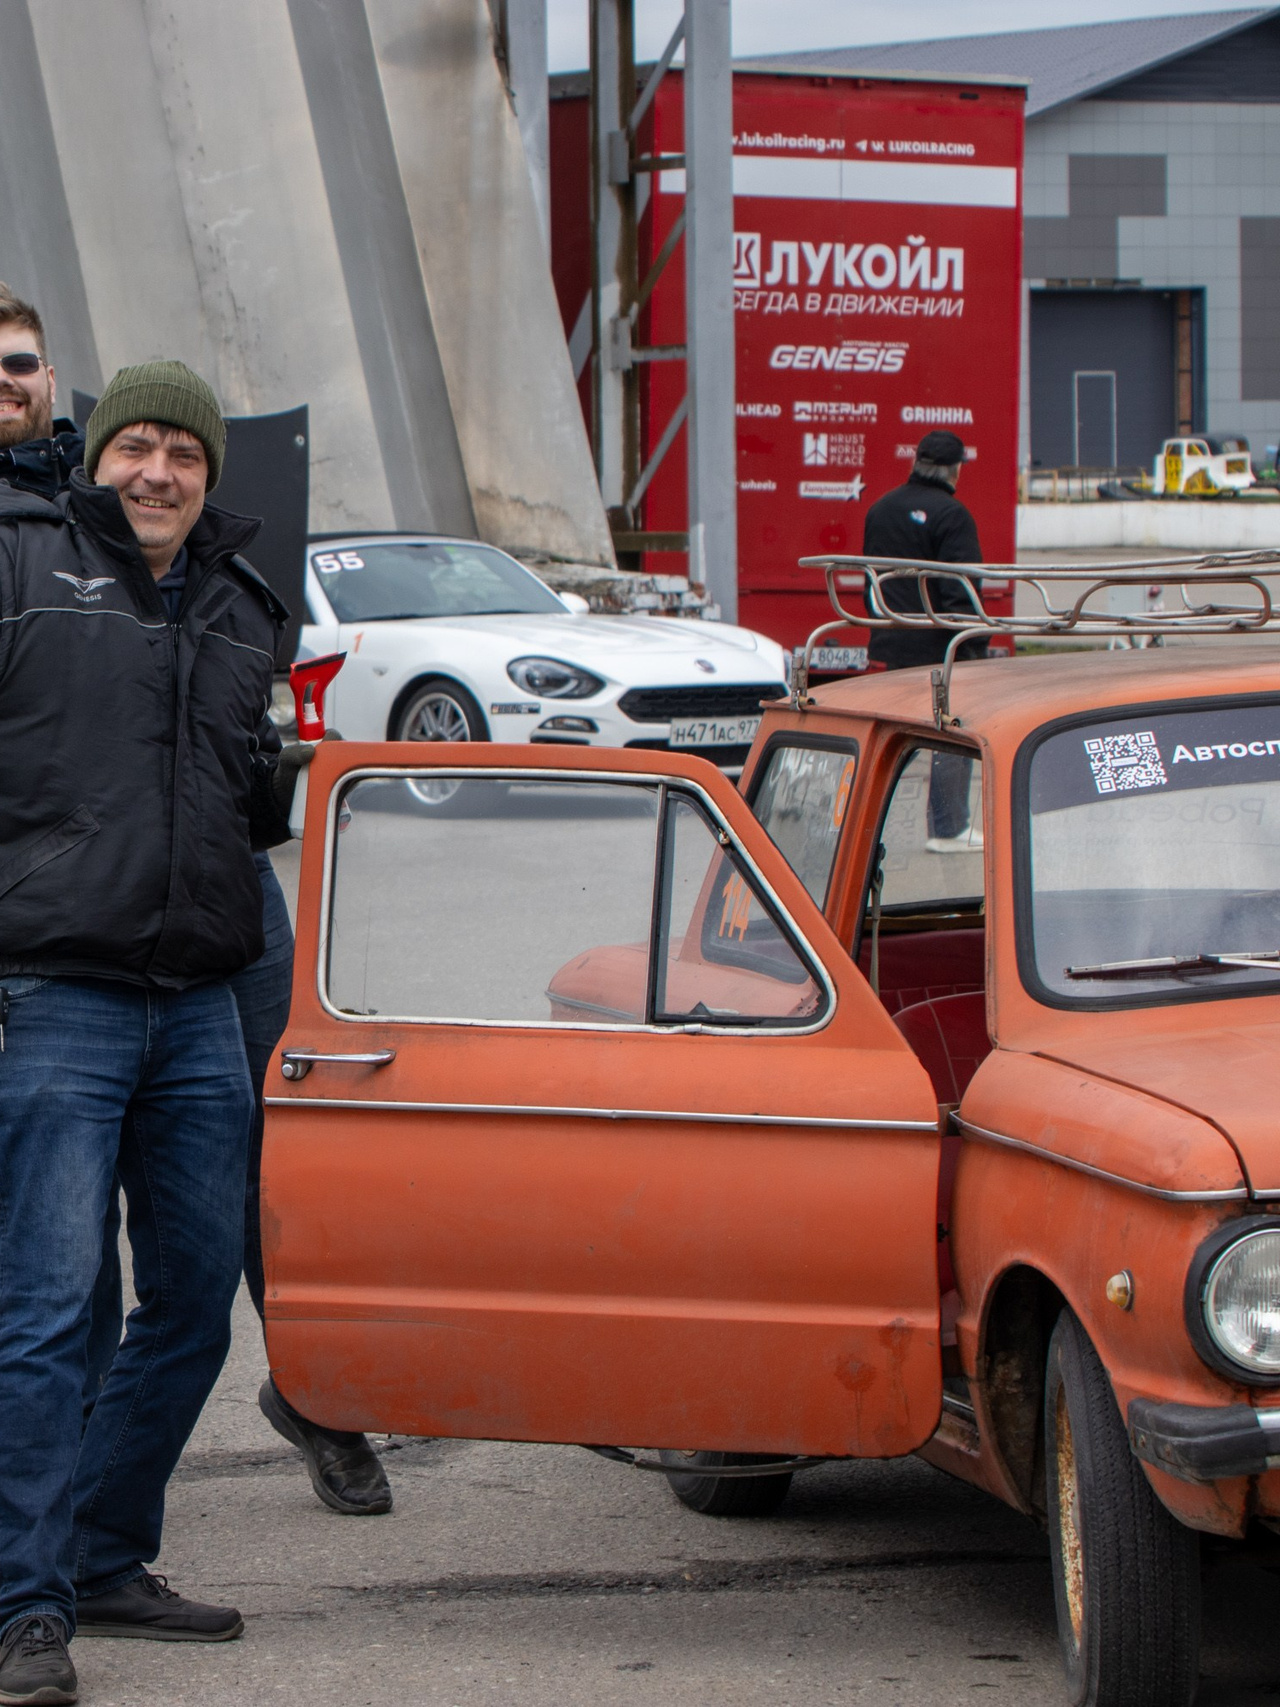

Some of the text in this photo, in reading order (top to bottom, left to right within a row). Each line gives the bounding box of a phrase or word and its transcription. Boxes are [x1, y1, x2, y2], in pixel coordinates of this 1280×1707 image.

[888, 141, 976, 156] LUKOILRACING
[765, 235, 965, 292] ЛУКОЙЛ
[733, 290, 965, 318] СЕГДА В ДВИЖЕНИИ
[770, 345, 907, 373] GENESIS
[736, 403, 782, 417] ILHEAD
[830, 433, 866, 444] HRUST
[830, 444, 866, 455] WORLD
[830, 455, 866, 466] PEACE
[740, 479, 777, 491] wheels
[314, 551, 366, 574] 55
[74, 592, 102, 602] GENESIS
[675, 722, 737, 742] Н471АС
